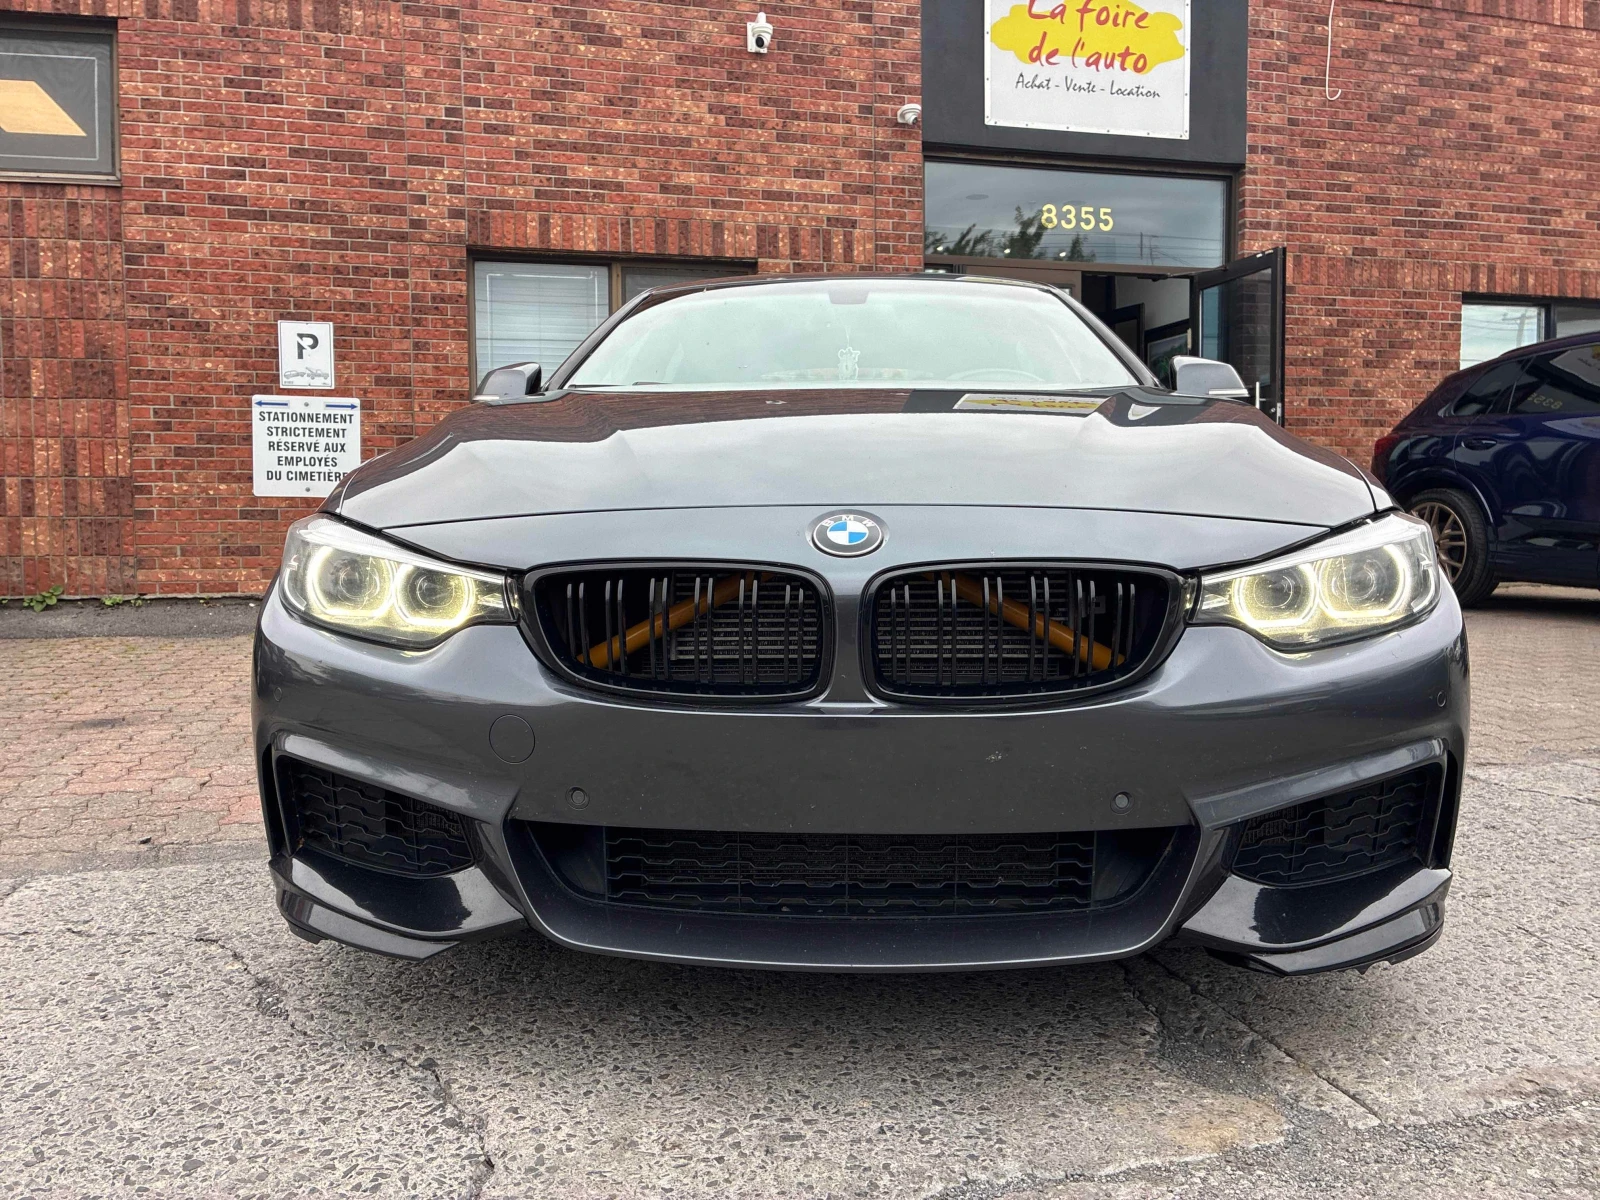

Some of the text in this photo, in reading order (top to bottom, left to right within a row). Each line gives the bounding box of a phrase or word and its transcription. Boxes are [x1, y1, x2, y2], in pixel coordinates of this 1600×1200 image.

[1027, 0, 1150, 33] La foire
[1028, 31, 1148, 74] de l'auto
[1015, 72, 1051, 89] Achat
[1064, 76, 1096, 94] Vente
[1110, 80, 1161, 98] Location
[1041, 203, 1114, 231] 8355
[296, 333, 319, 359] P
[258, 411, 354, 424] STATIONNEMENT
[266, 426, 347, 438] STRICTEMENT
[268, 439, 346, 453] RÉSERVÉ AUX
[277, 454, 338, 467] EMPLOYÉS
[266, 471, 282, 481] DU
[821, 514, 876, 527] BMW
